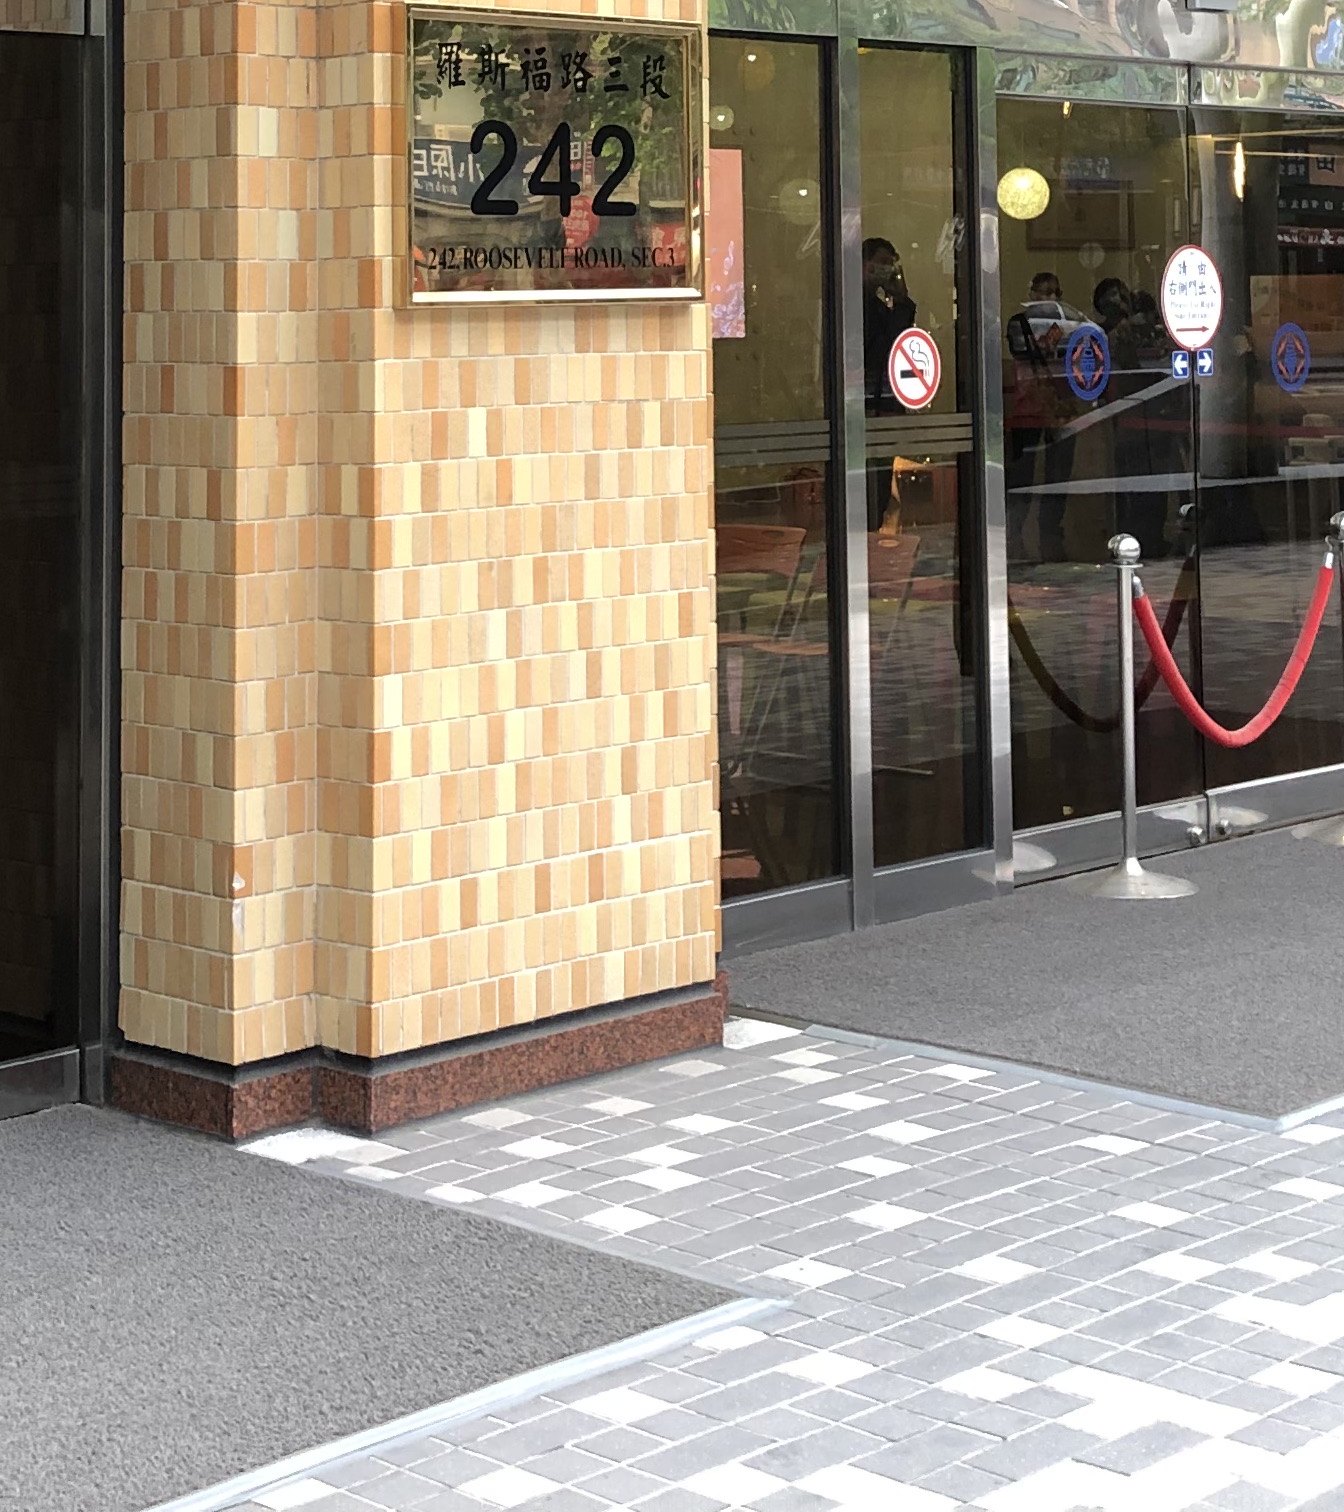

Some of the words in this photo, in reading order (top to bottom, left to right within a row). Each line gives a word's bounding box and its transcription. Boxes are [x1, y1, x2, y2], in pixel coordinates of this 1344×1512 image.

[437, 42, 671, 99] 羅斯福路三段
[470, 119, 637, 217] 242
